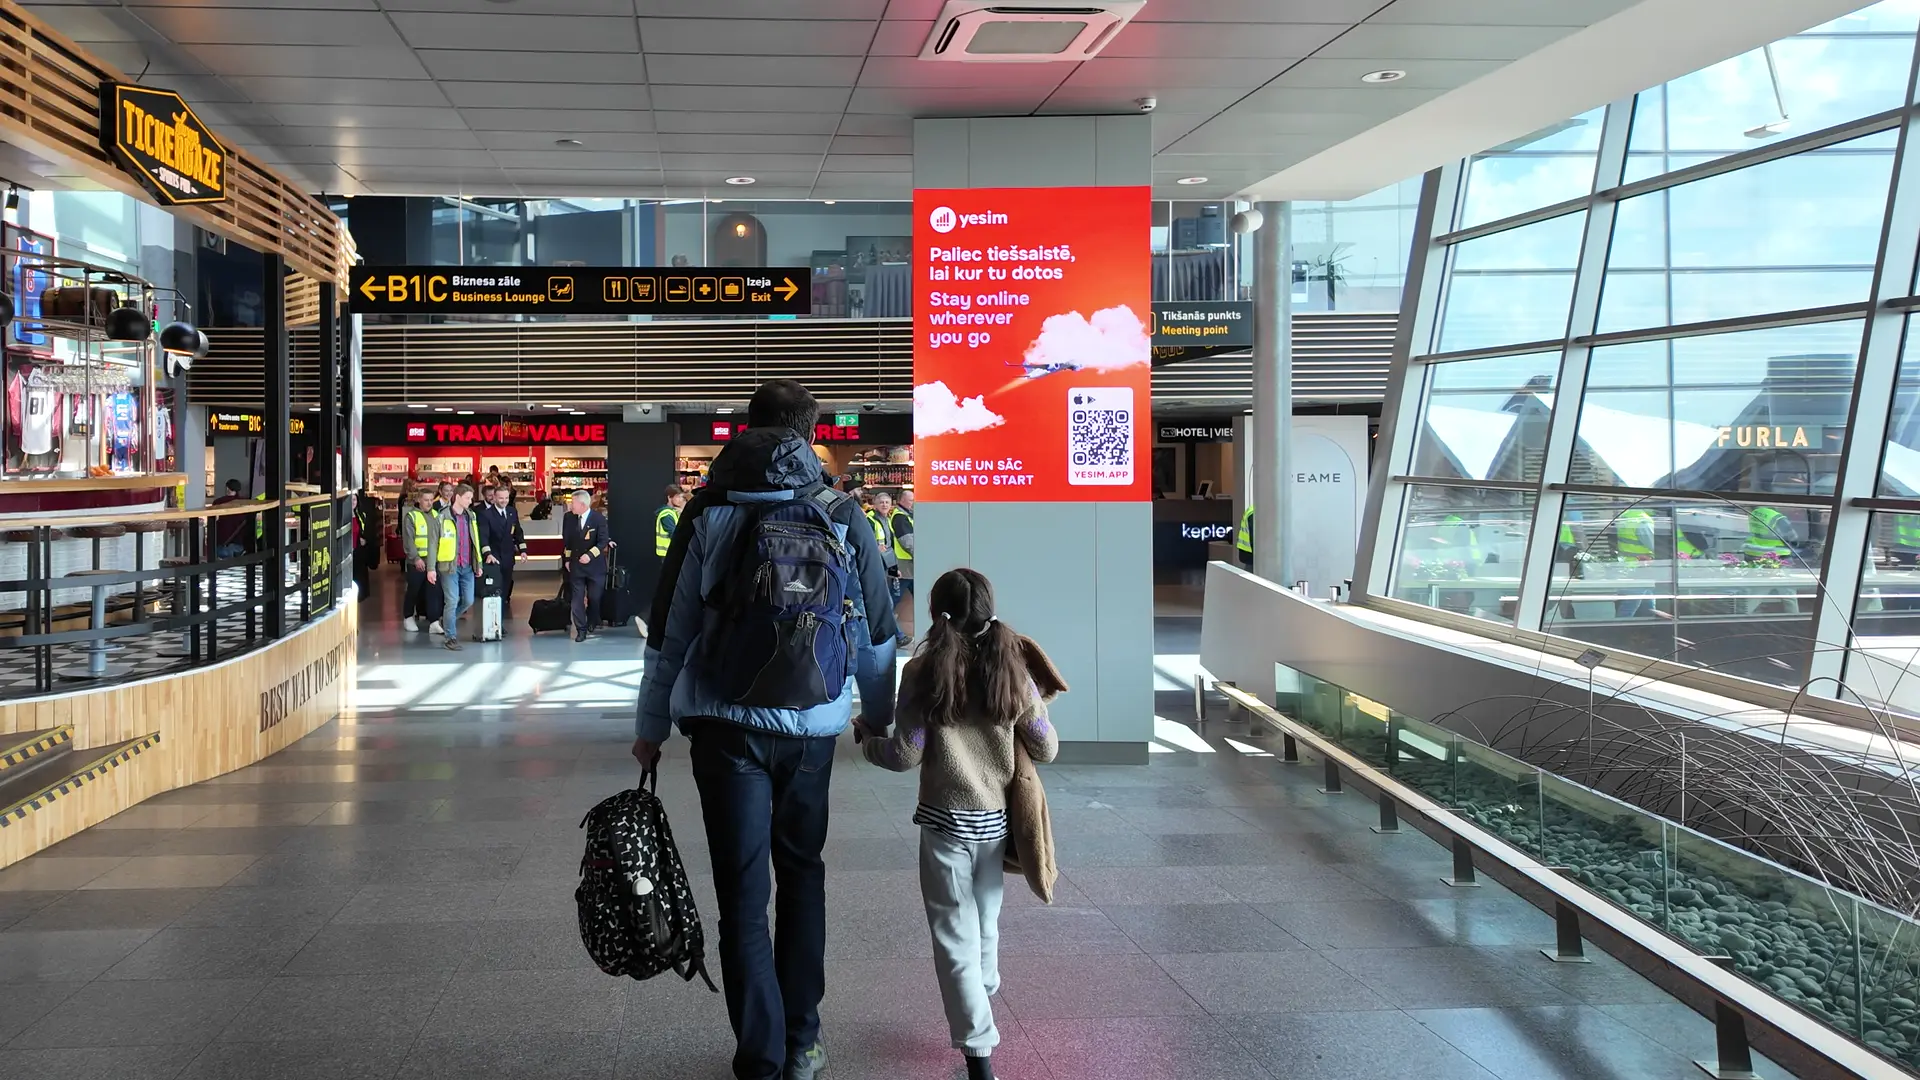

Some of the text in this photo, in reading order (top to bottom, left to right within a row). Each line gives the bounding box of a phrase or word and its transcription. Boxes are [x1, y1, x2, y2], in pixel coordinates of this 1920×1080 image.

[958, 210, 1008, 228] yesim
[930, 245, 1076, 262] Paliec tiešsaistē,
[929, 265, 1063, 281] lai kur tu dotos
[452, 275, 521, 286] Biznesa zāle
[746, 276, 771, 288] Izeja
[452, 291, 545, 304] Business Lounge
[751, 292, 771, 302] Exit
[930, 290, 1030, 310] Stay online
[929, 311, 1013, 325] wherever
[1162, 310, 1241, 322] Tikšanās punkts
[1162, 325, 1229, 337] Meeting point
[929, 331, 991, 348] you go
[432, 424, 503, 442] TRAV
[528, 424, 605, 442] VALUE
[815, 424, 860, 440] REE
[1176, 428, 1208, 437] HOTEL
[1718, 426, 1808, 447] FURLA
[931, 458, 1022, 471] SKENĒ UN SĀC
[931, 475, 1034, 485] SCAN TO START
[1074, 470, 1129, 479] YESIM.APP
[1291, 473, 1341, 483] EAME
[259, 680, 290, 734] BEST
[291, 661, 312, 713] WAY
[313, 656, 324, 695] TO
